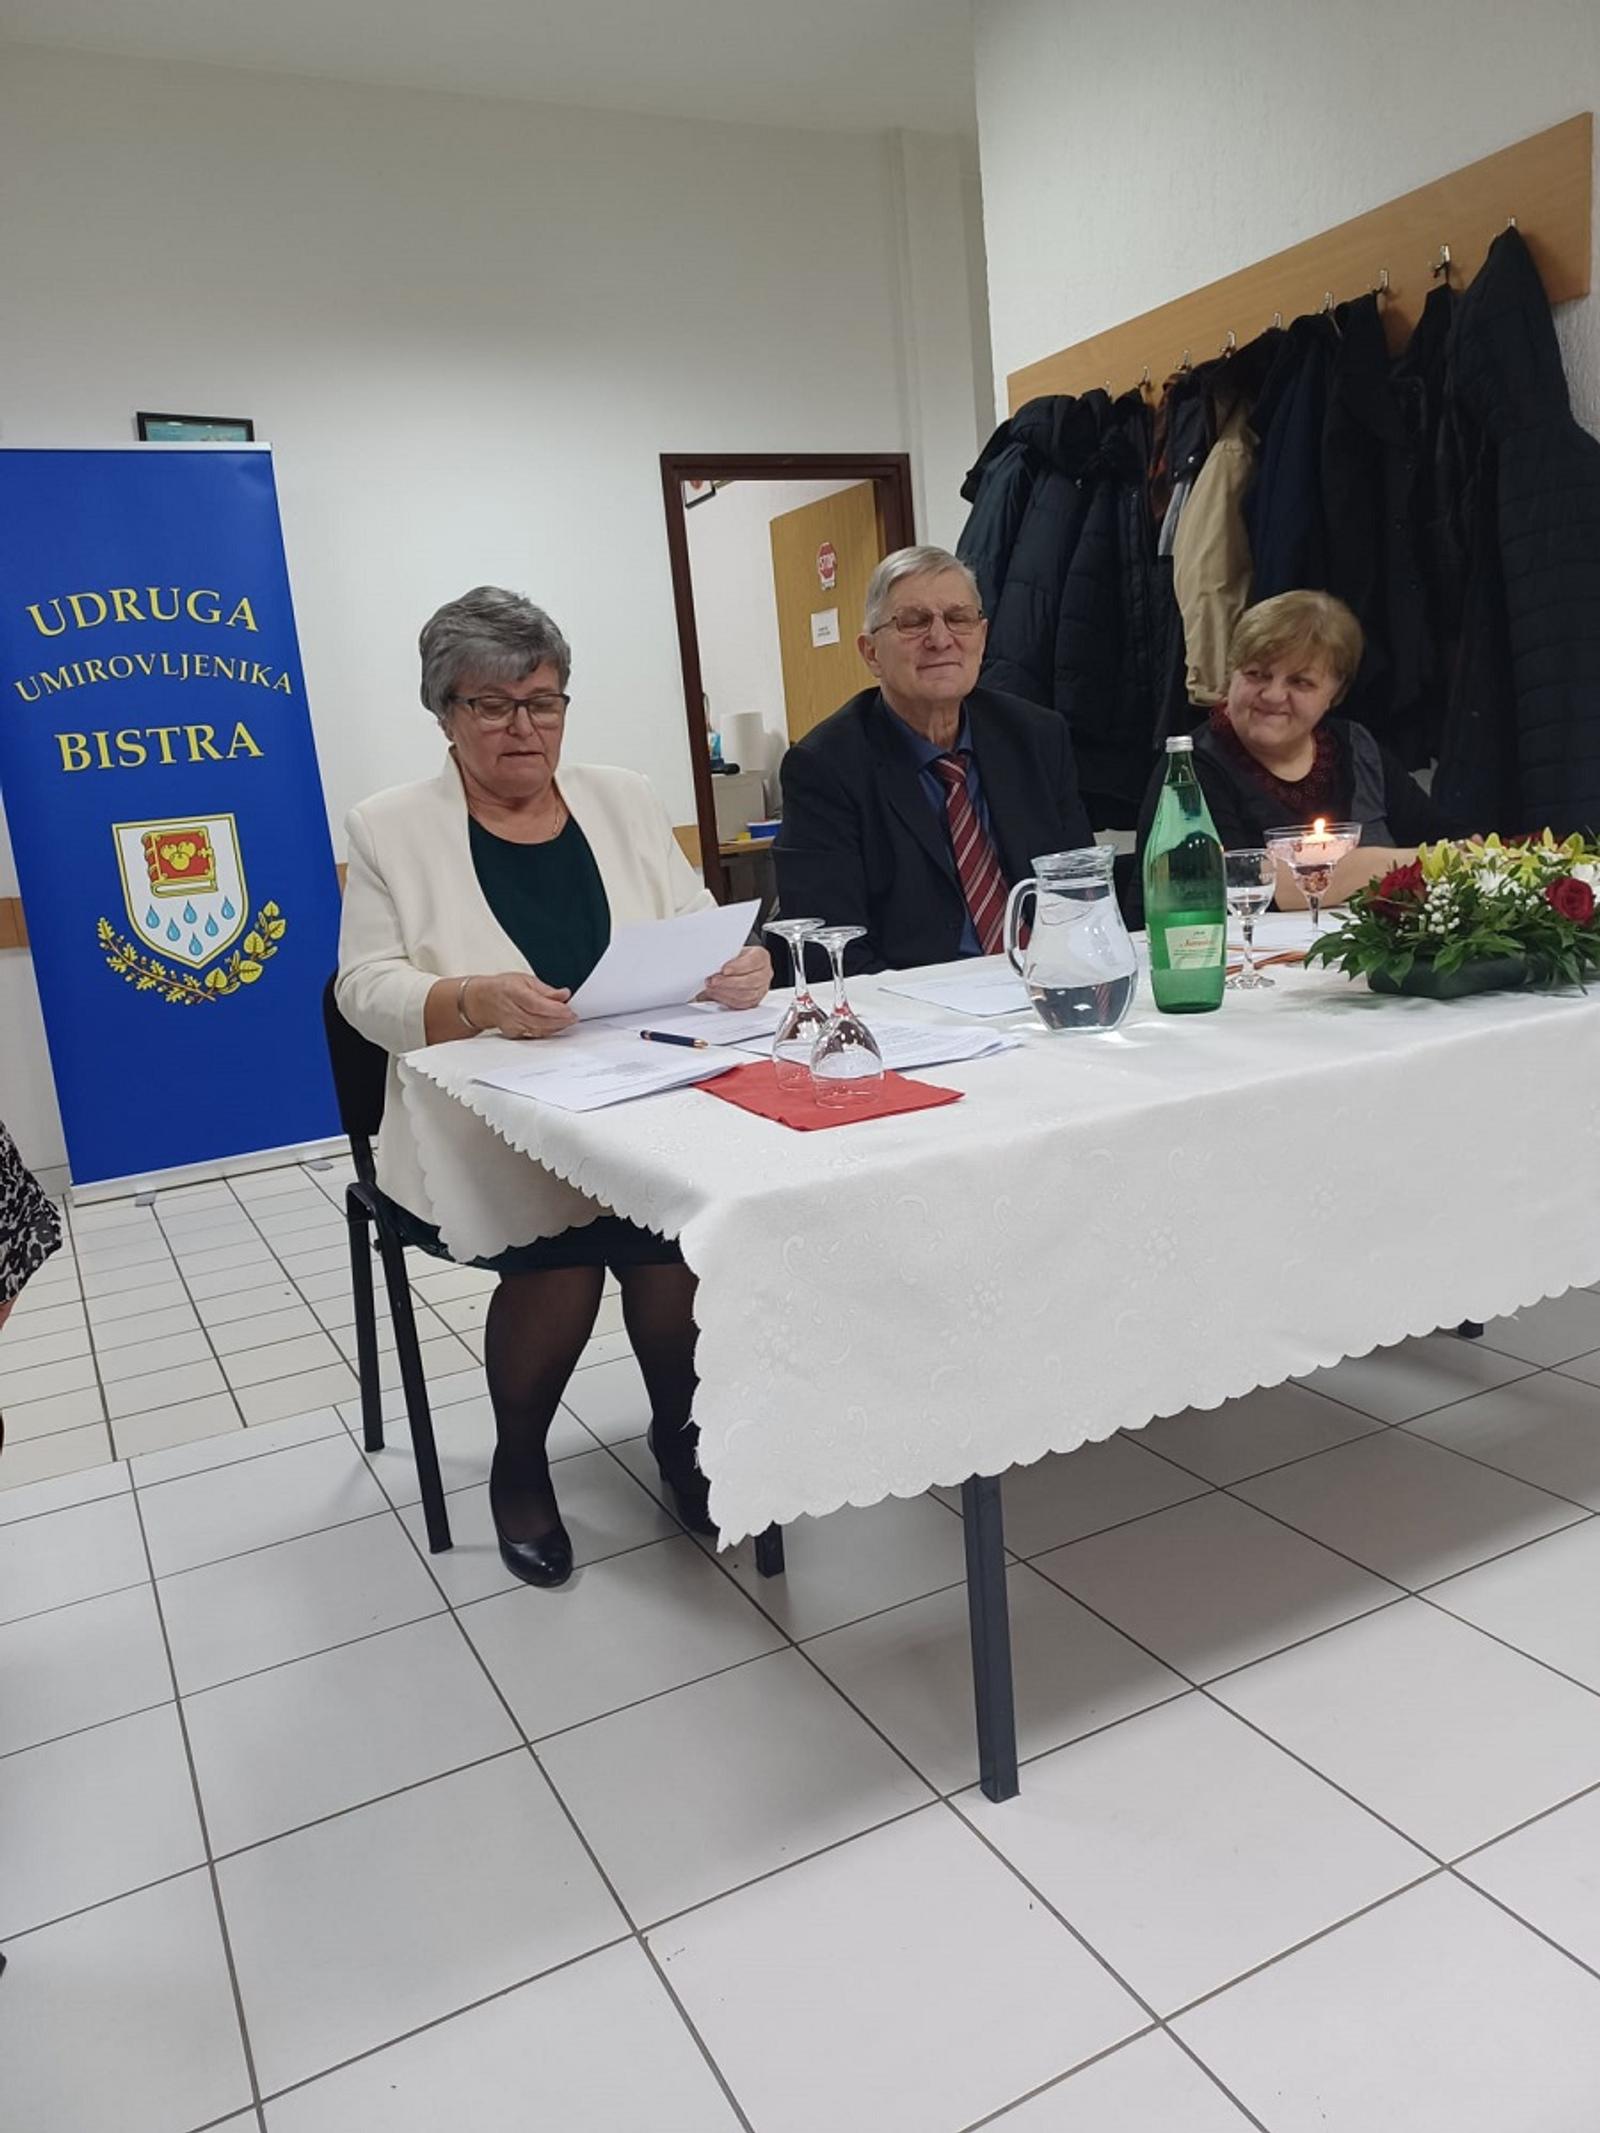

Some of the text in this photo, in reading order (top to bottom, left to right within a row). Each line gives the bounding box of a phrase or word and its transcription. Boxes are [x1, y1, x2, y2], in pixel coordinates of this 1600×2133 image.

[26, 587, 258, 636] UDRUGA
[14, 652, 291, 702] UMIROVLJENIKA
[54, 721, 264, 772] BISTRA
